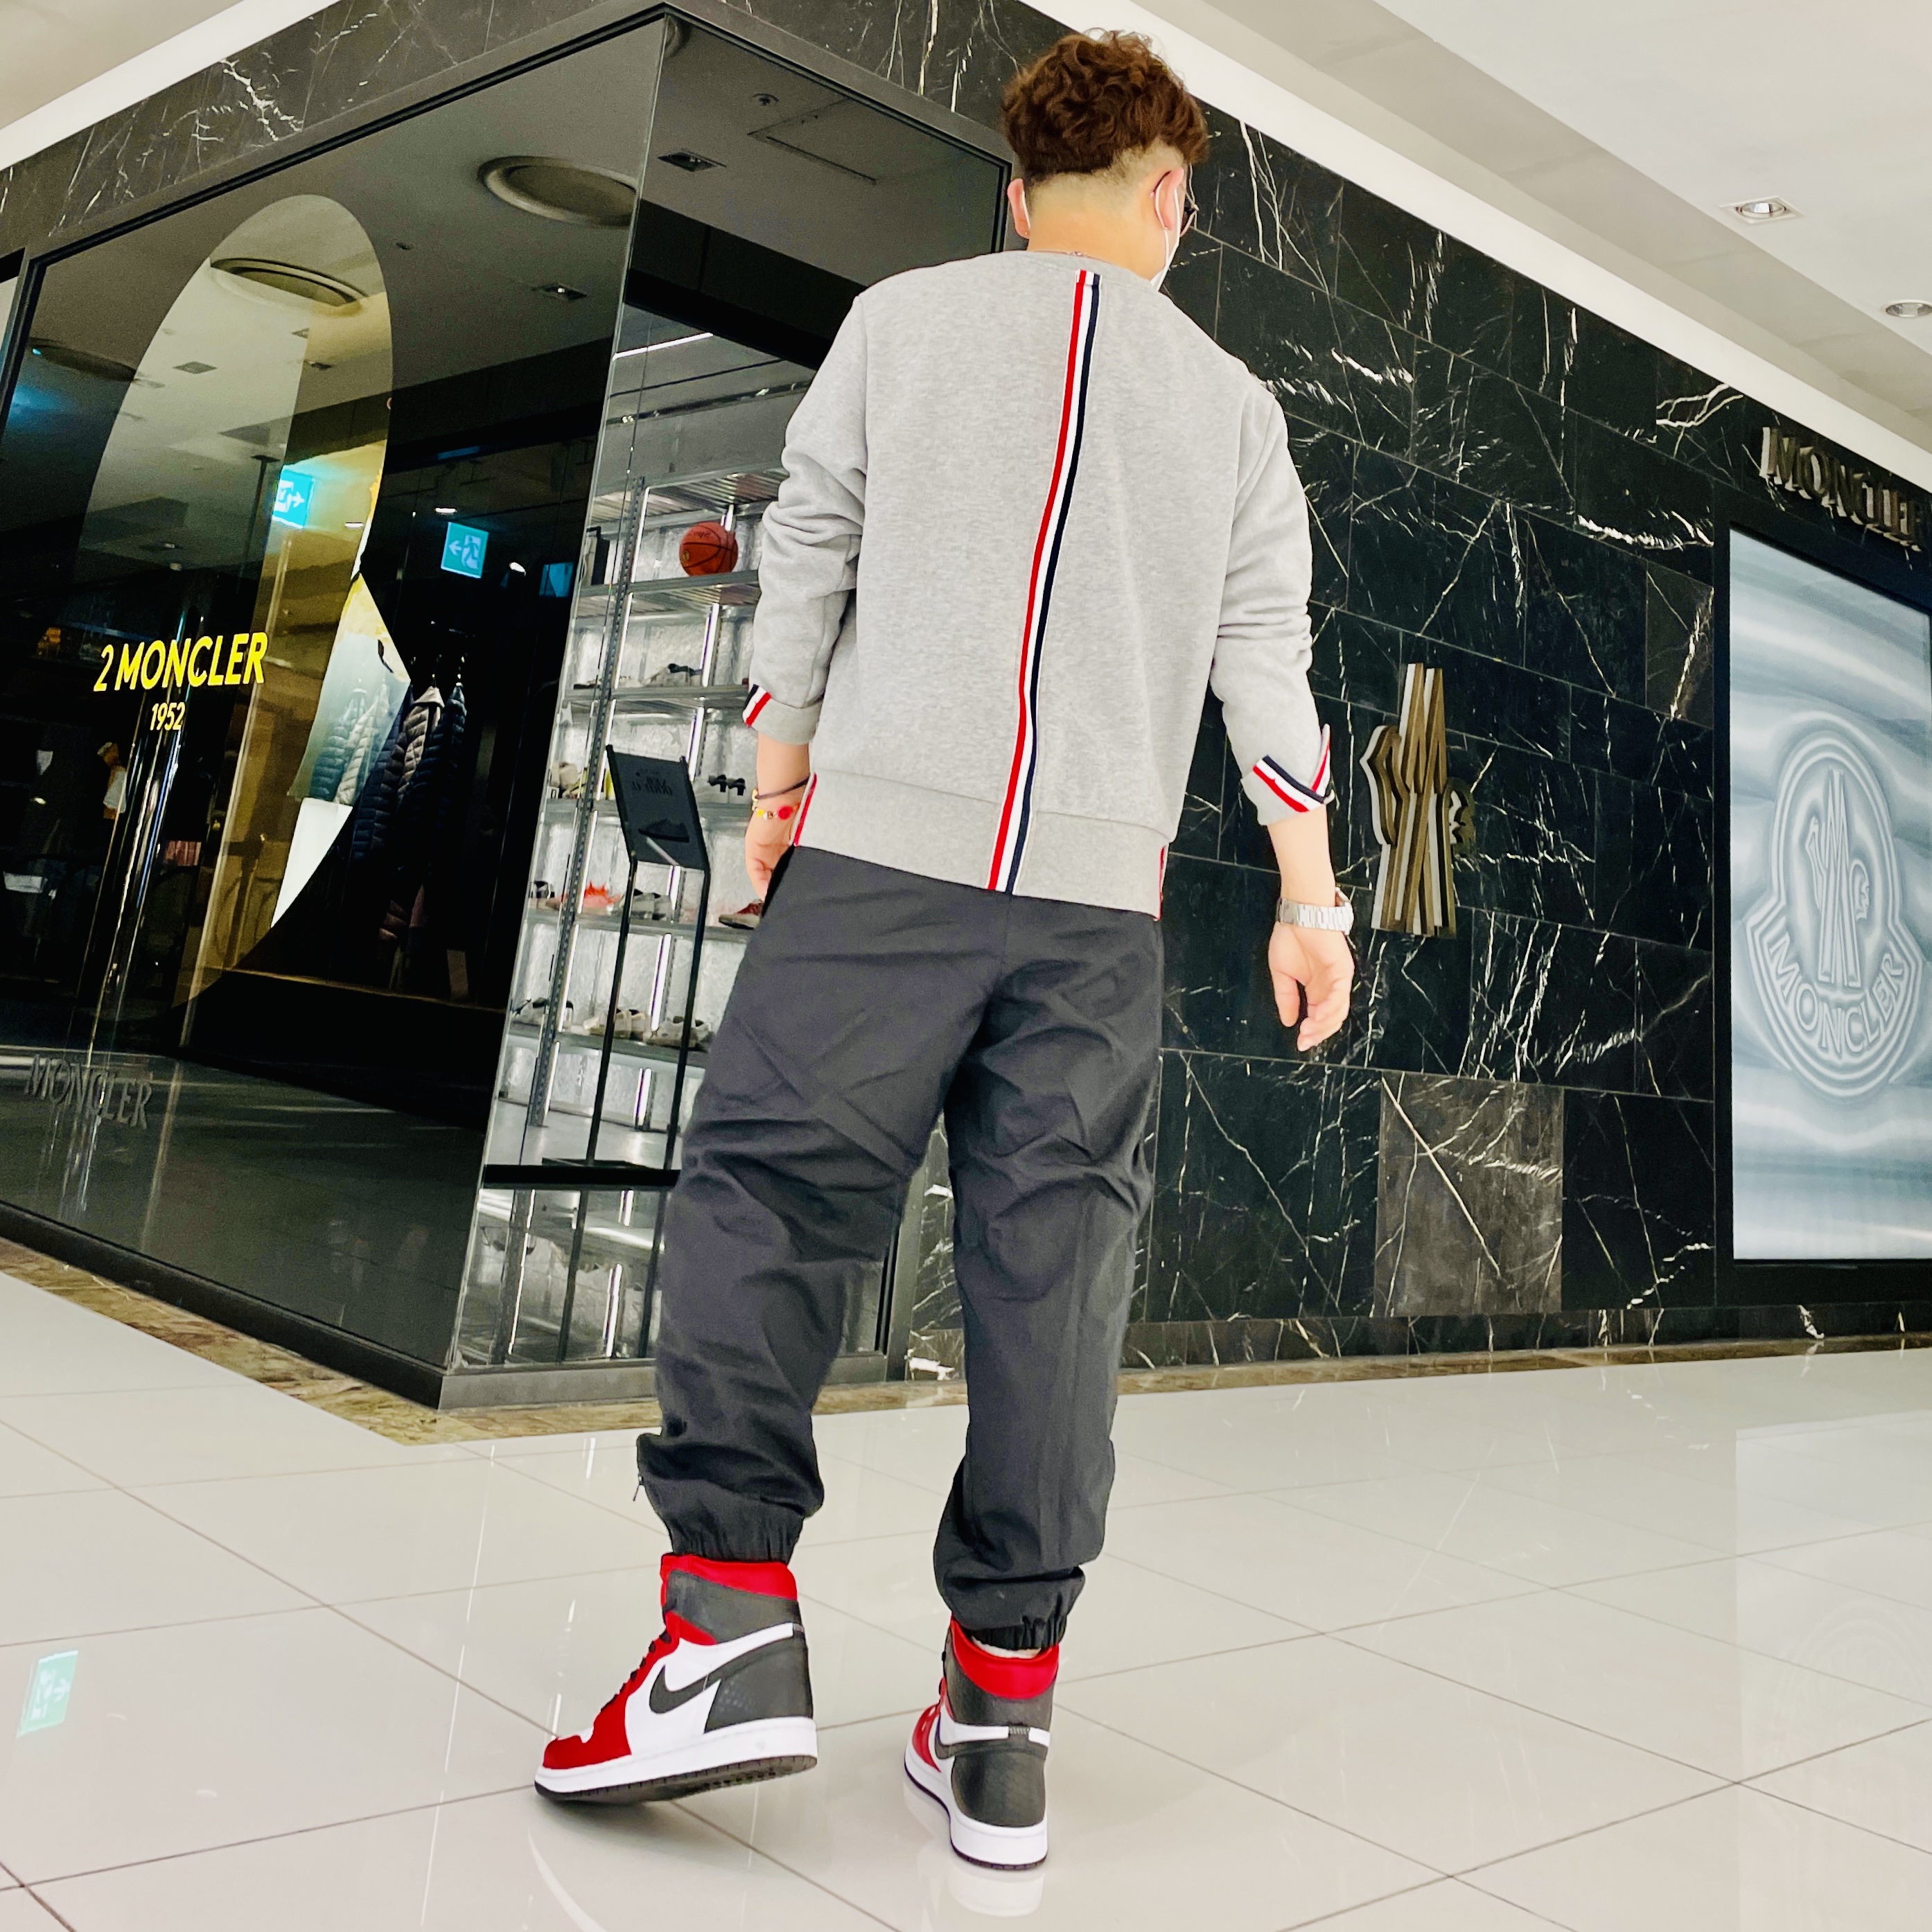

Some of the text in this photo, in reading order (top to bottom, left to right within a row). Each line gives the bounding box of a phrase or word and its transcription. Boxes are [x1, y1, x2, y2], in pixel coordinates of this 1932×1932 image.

[93, 631, 268, 692] 2 MONCLER
[150, 701, 186, 731] 1952
[1768, 931, 1906, 1054] MONCLER
[24, 1053, 152, 1130] MONCLER
